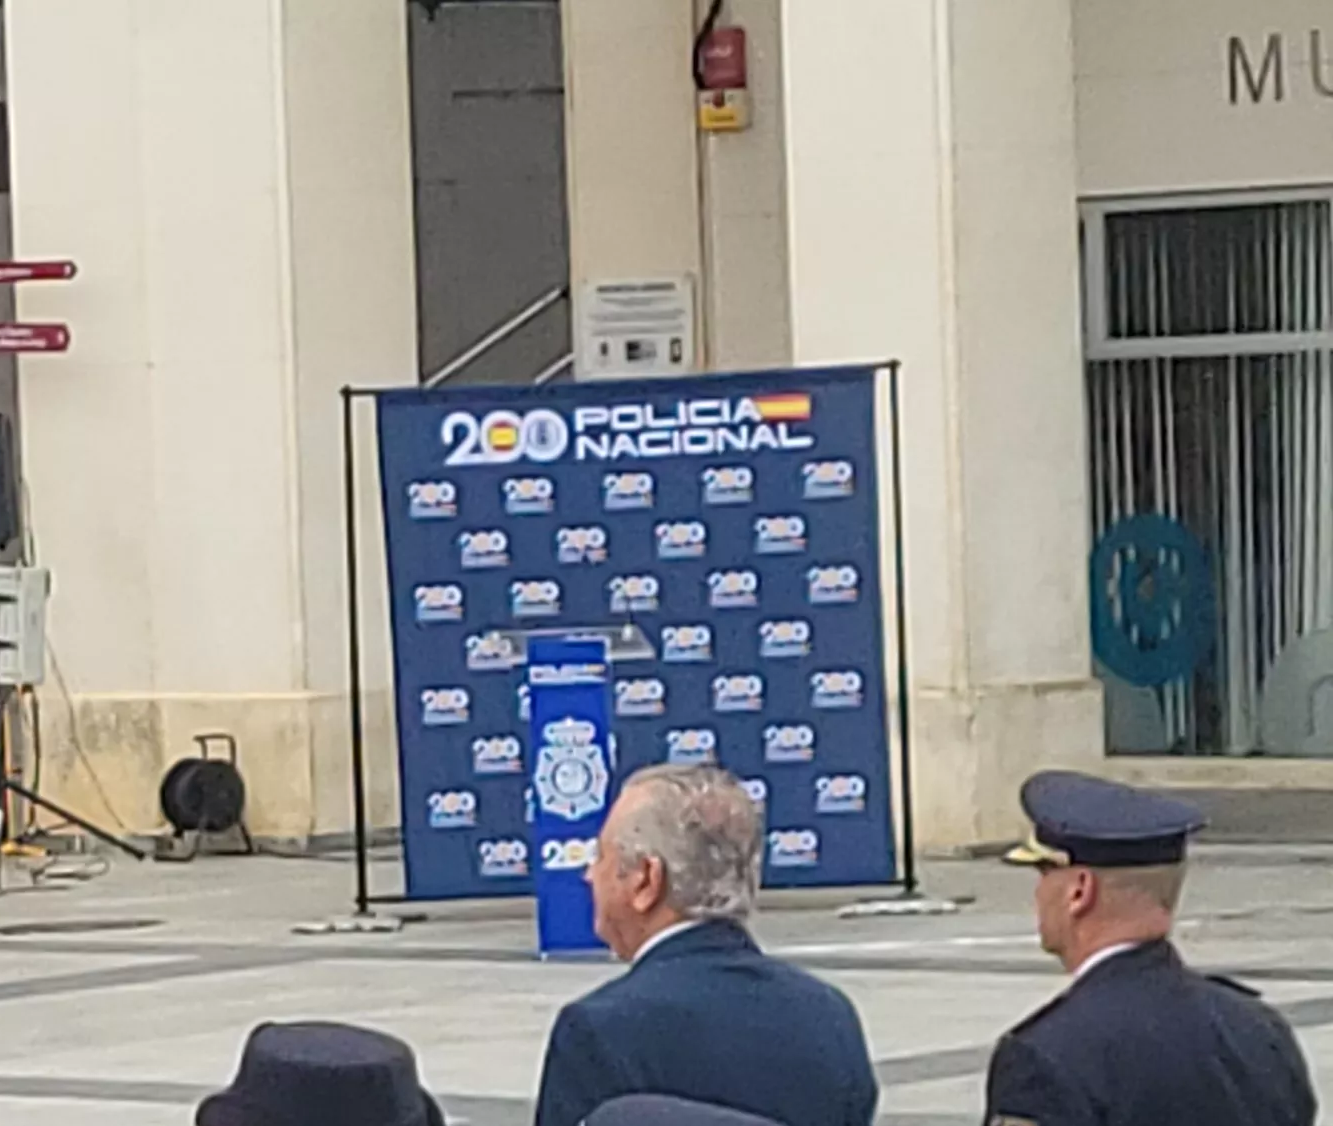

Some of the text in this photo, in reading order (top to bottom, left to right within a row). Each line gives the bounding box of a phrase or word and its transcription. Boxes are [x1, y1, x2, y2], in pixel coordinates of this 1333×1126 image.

[575, 397, 761, 432] POLICIA
[441, 409, 569, 466] 200
[575, 424, 813, 461] NACIONAL
